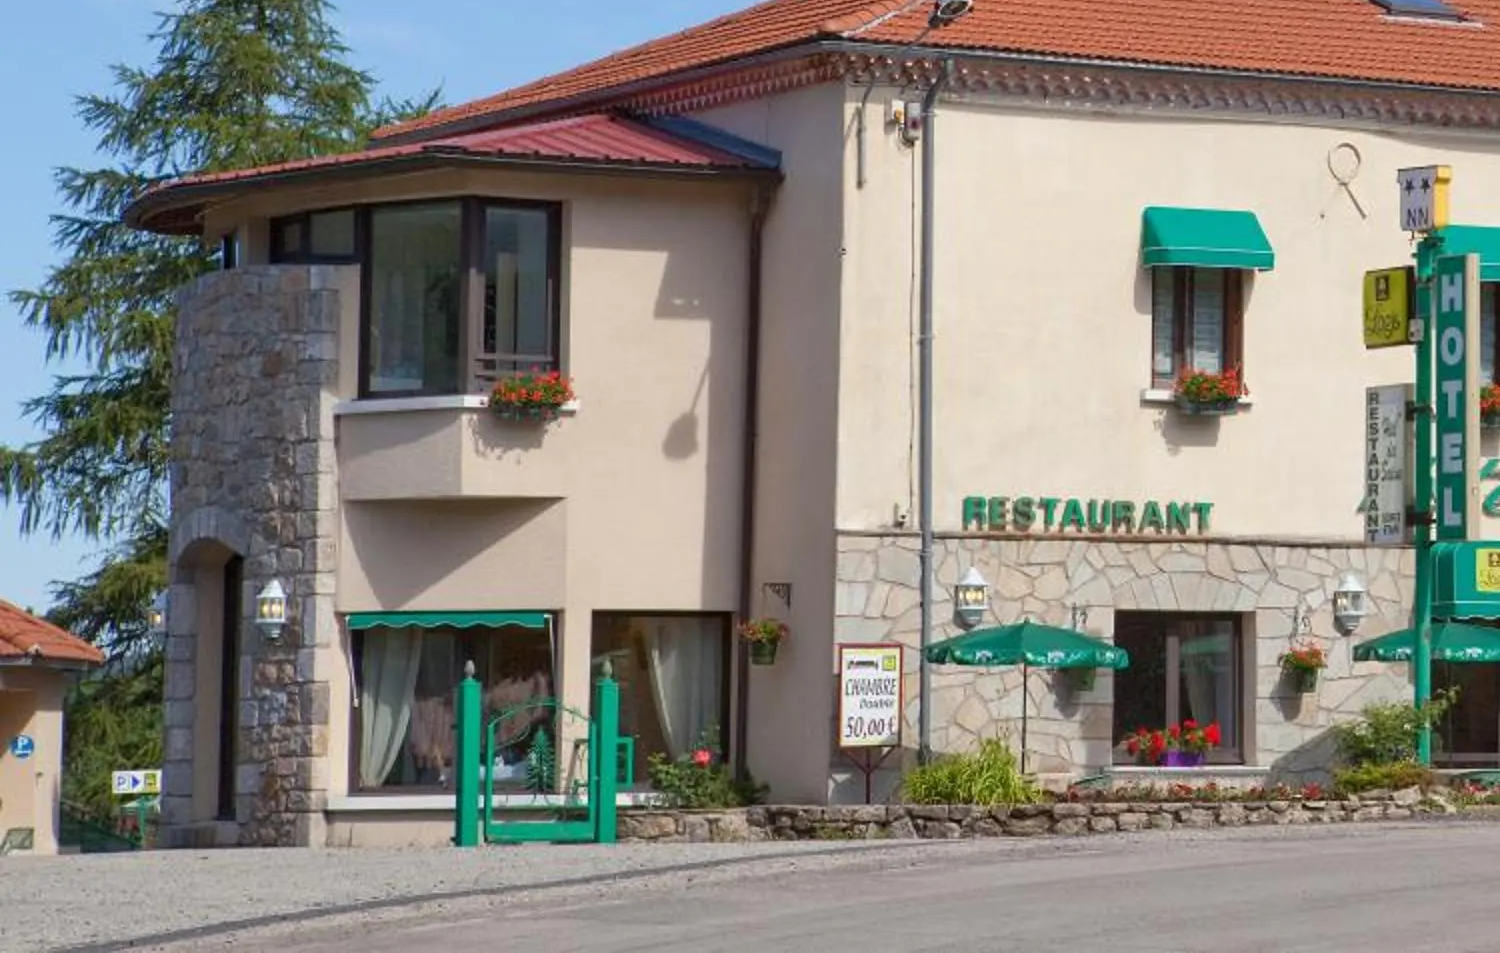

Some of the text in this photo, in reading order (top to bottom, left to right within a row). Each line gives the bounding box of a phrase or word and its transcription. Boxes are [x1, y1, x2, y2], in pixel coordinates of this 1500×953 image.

[1406, 207, 1429, 227] NN
[1440, 272, 1465, 528] HOTEL
[1367, 392, 1379, 542] RESTAURANT
[961, 495, 1215, 535] RESTAURANT
[846, 677, 896, 696] CHAMBRE
[17, 736, 28, 750] P
